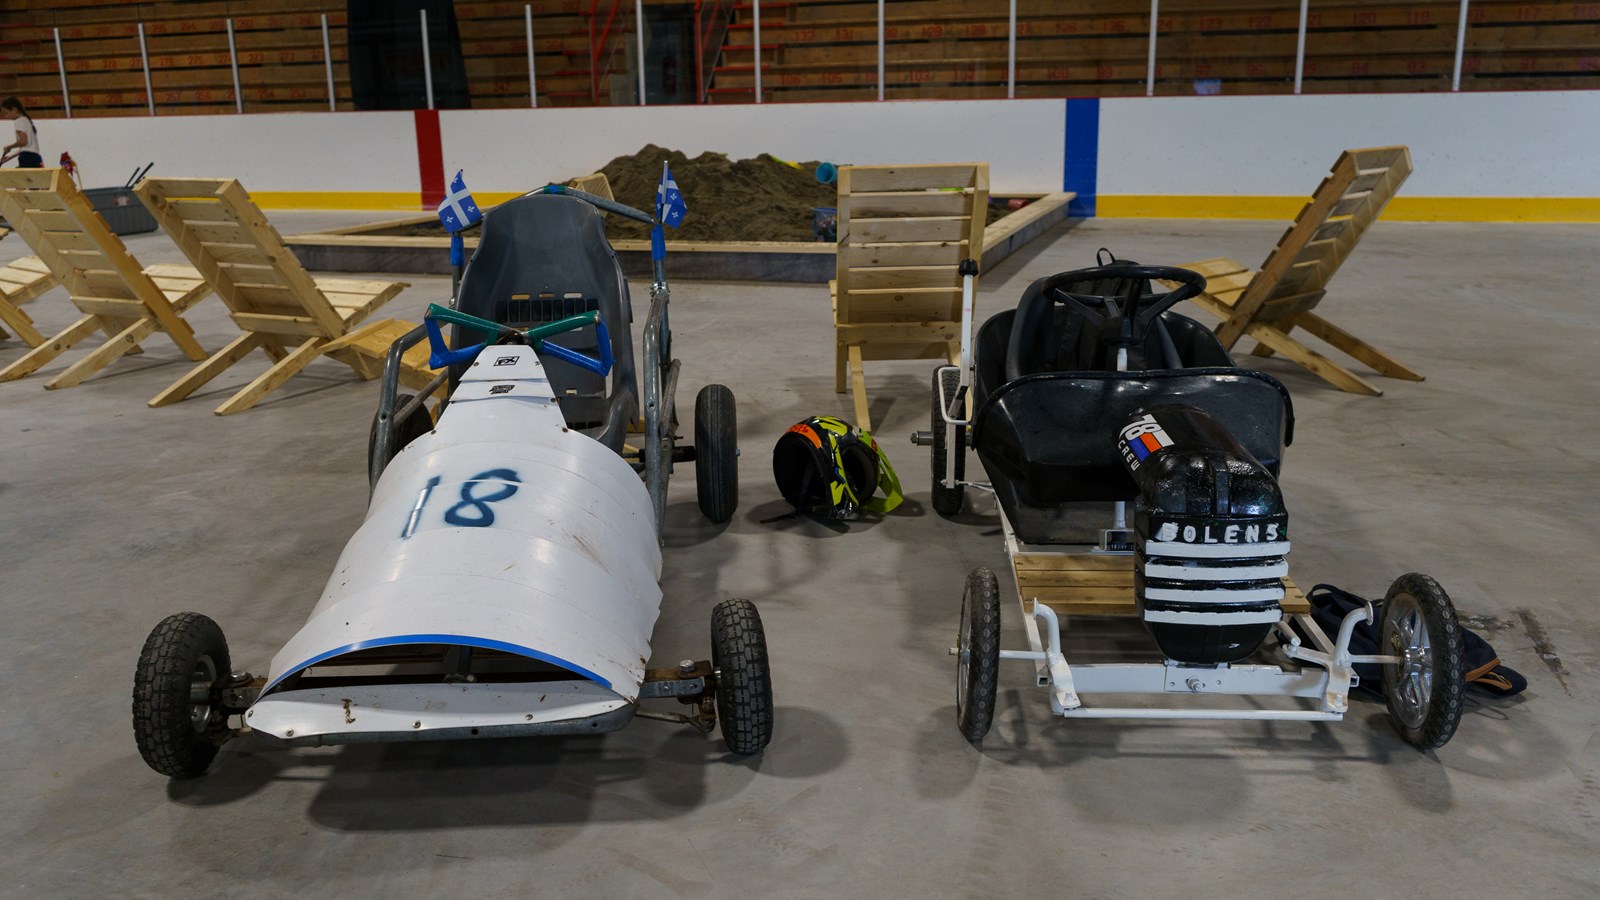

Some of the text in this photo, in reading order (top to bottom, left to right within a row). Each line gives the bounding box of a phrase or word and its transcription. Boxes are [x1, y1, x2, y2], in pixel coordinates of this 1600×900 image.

[1158, 18, 1173, 29] 24
[1308, 14, 1322, 25] 21
[1017, 23, 1031, 34] 27
[795, 31, 815, 41] 132
[836, 29, 854, 40] 131
[909, 70, 931, 82] 103
[1119, 414, 1162, 441] 18
[1118, 440, 1141, 471] CREW
[401, 468, 522, 540] 18
[1155, 522, 1279, 543] BOLENS
